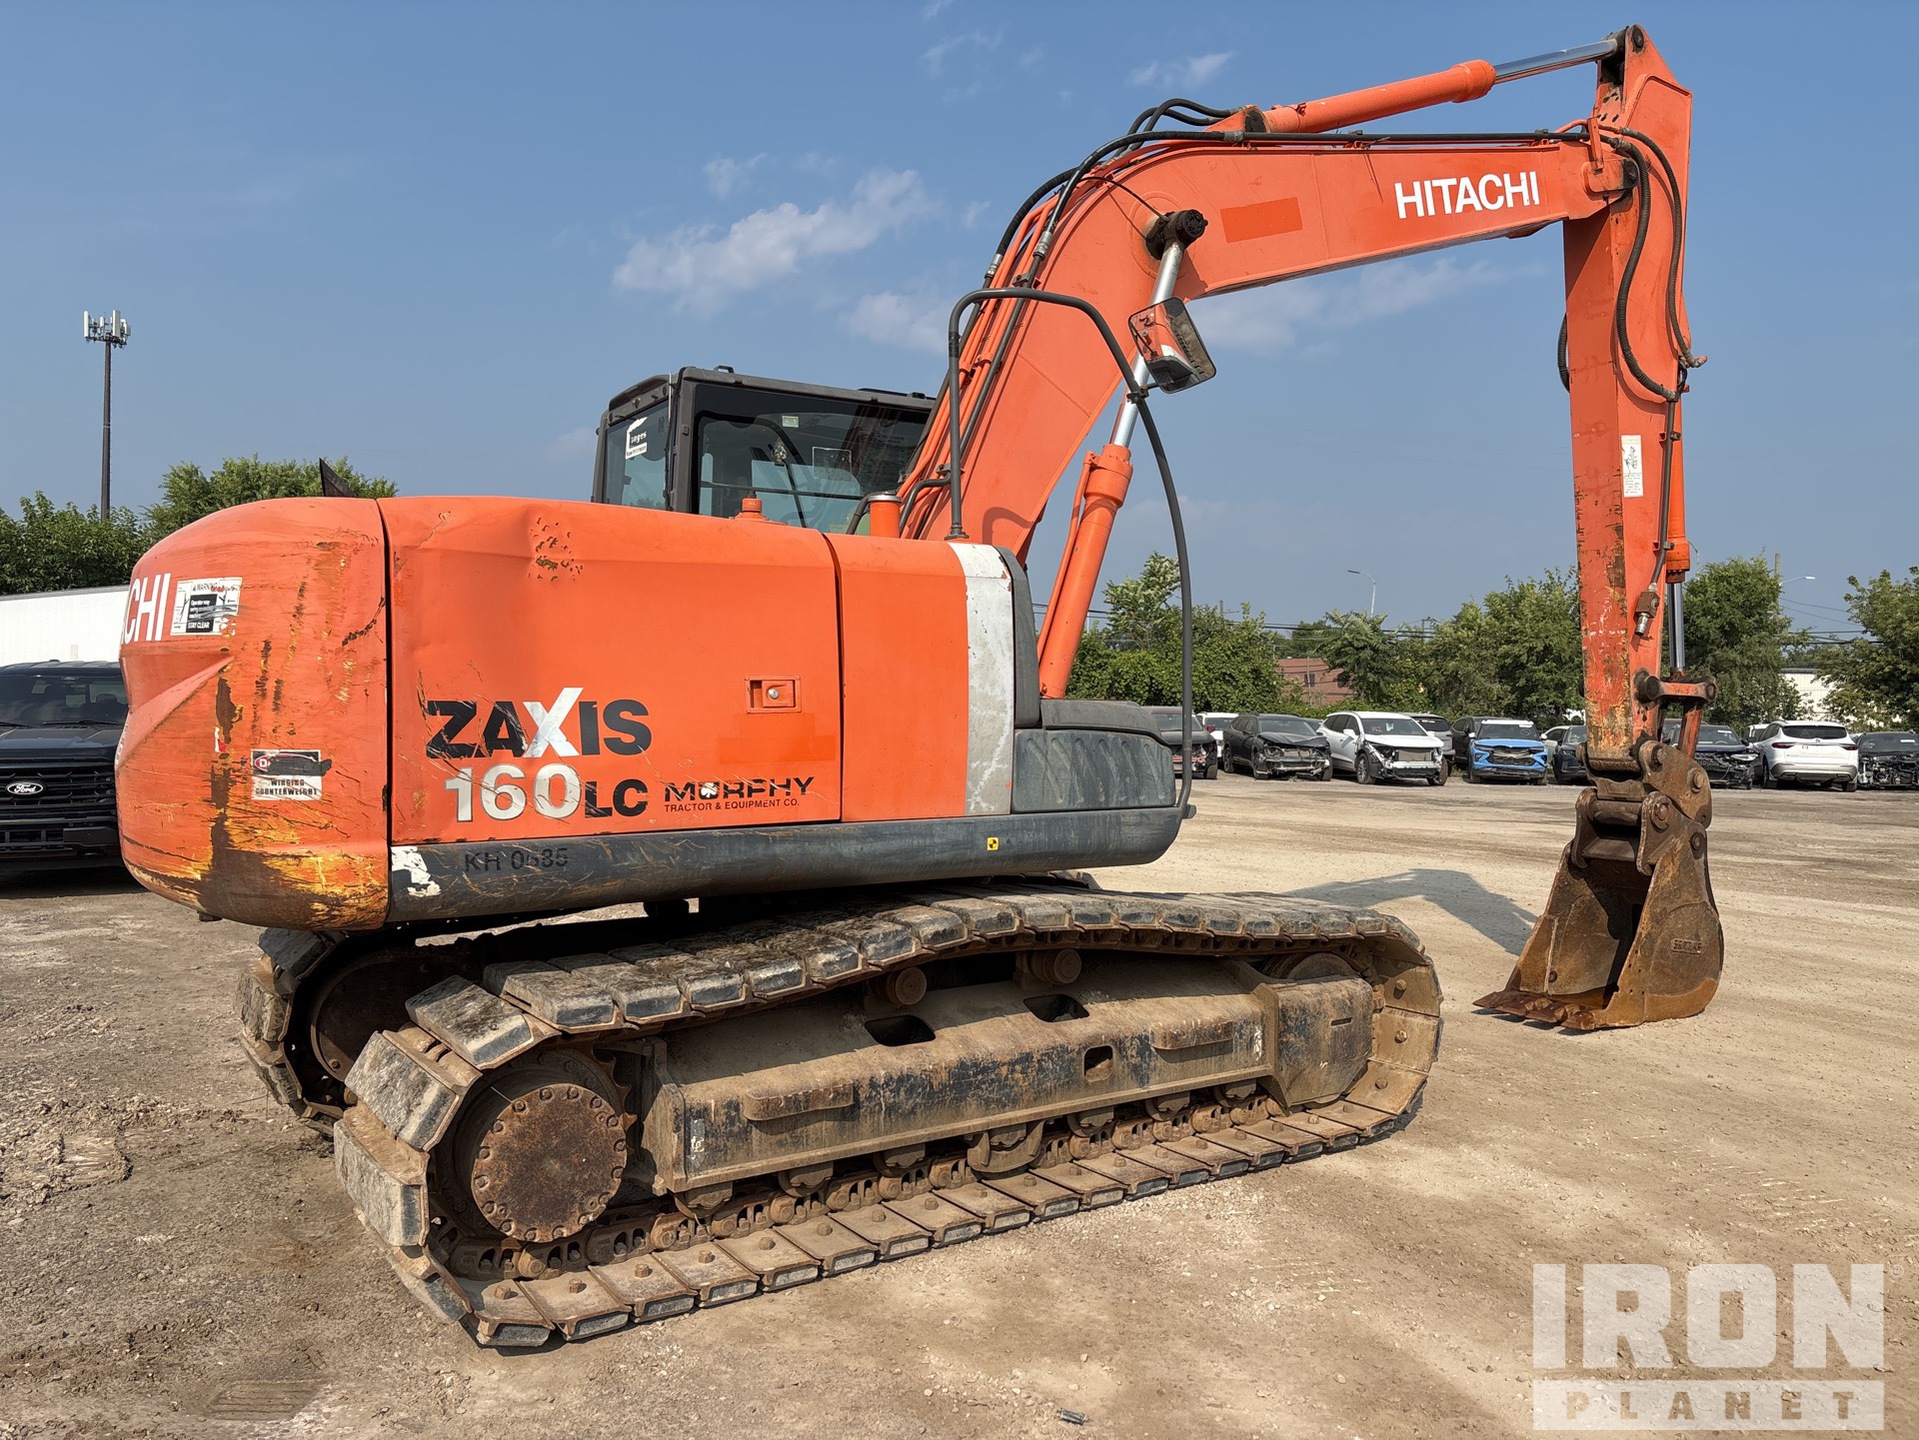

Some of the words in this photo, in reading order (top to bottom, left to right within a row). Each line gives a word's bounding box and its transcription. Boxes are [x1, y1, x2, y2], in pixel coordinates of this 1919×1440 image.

[1394, 171, 1540, 219] HITACHI
[121, 573, 171, 644] CHI
[197, 621, 210, 629] CLEAR
[426, 687, 652, 758] ZAXIS
[13, 783, 37, 793] Ford
[665, 803, 712, 812] TRACTOR
[725, 799, 781, 810] EQUIPMENT
[784, 799, 800, 807] CO.
[465, 852, 501, 872] KH
